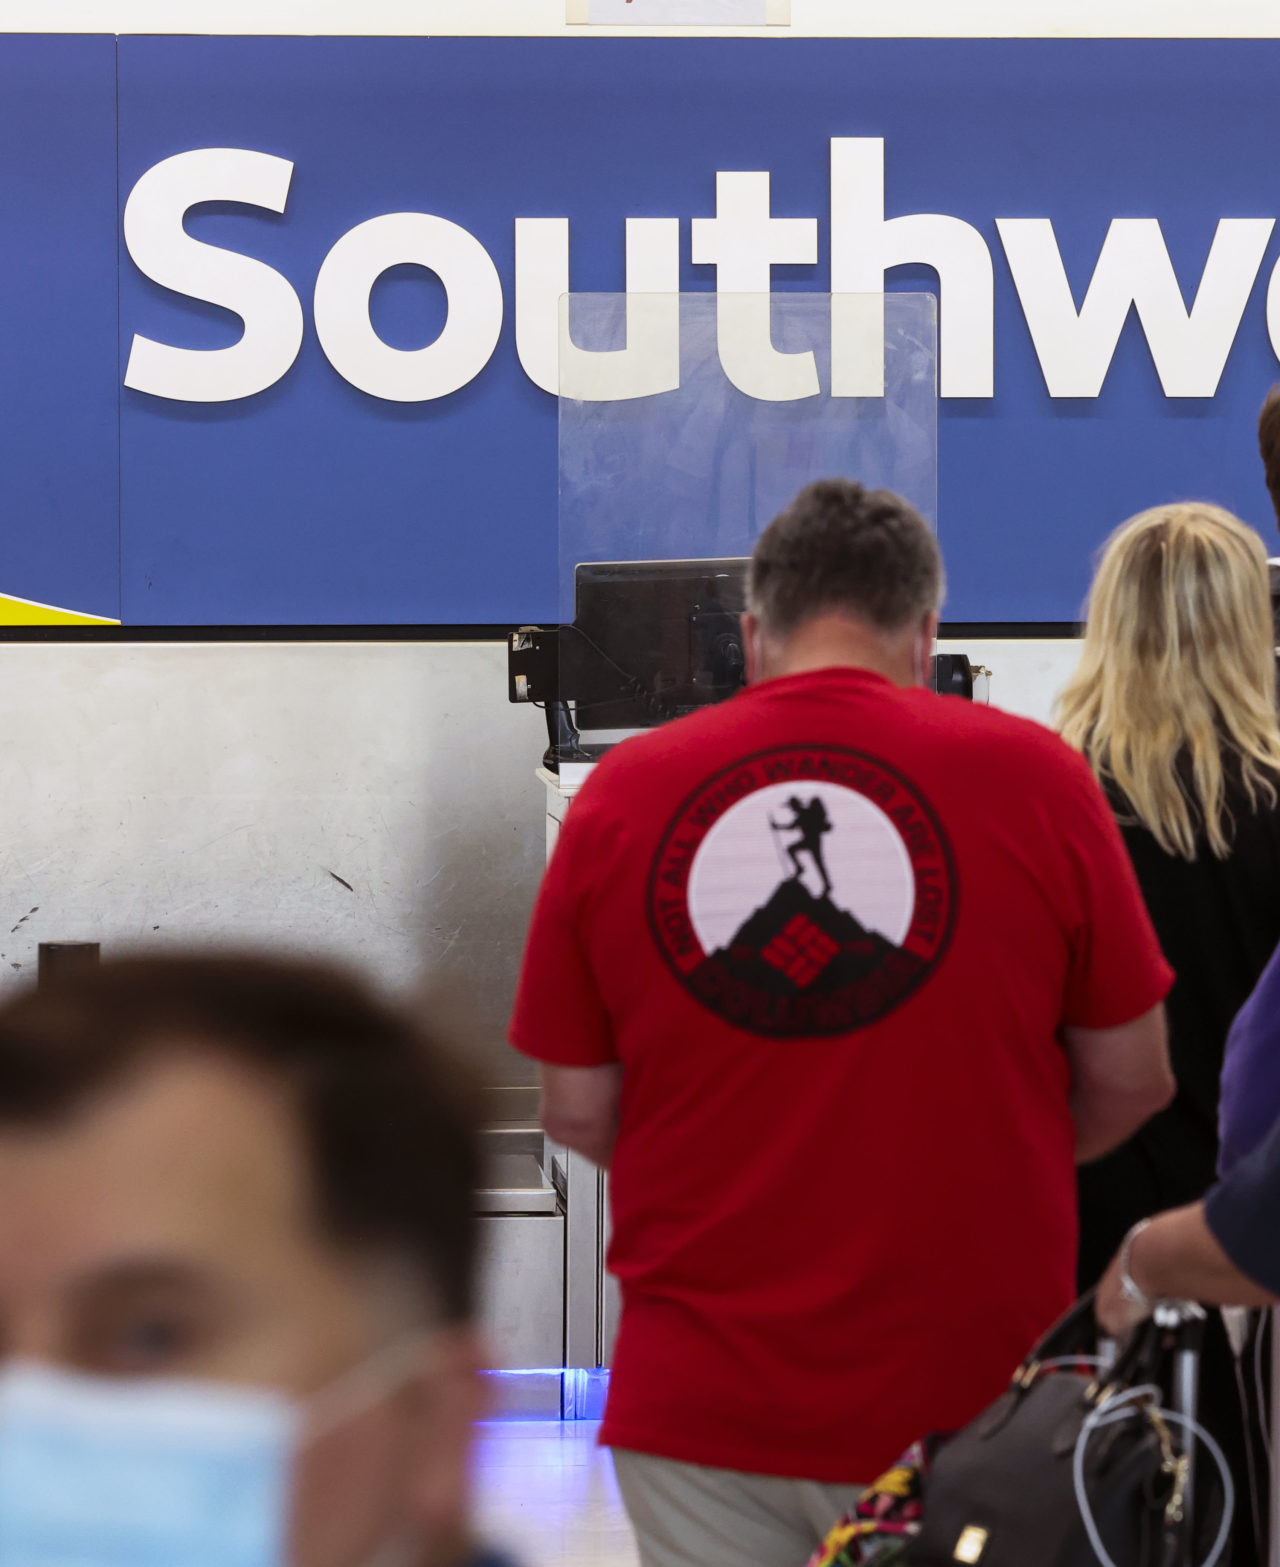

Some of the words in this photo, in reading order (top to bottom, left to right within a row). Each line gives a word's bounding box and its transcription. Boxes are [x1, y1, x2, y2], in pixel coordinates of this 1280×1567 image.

[692, 773, 757, 827] WHO
[763, 758, 897, 801] WANDER
[894, 804, 936, 860] ARE
[664, 837, 697, 887] ALL
[663, 900, 694, 955] NOT
[917, 866, 944, 945] LOST
